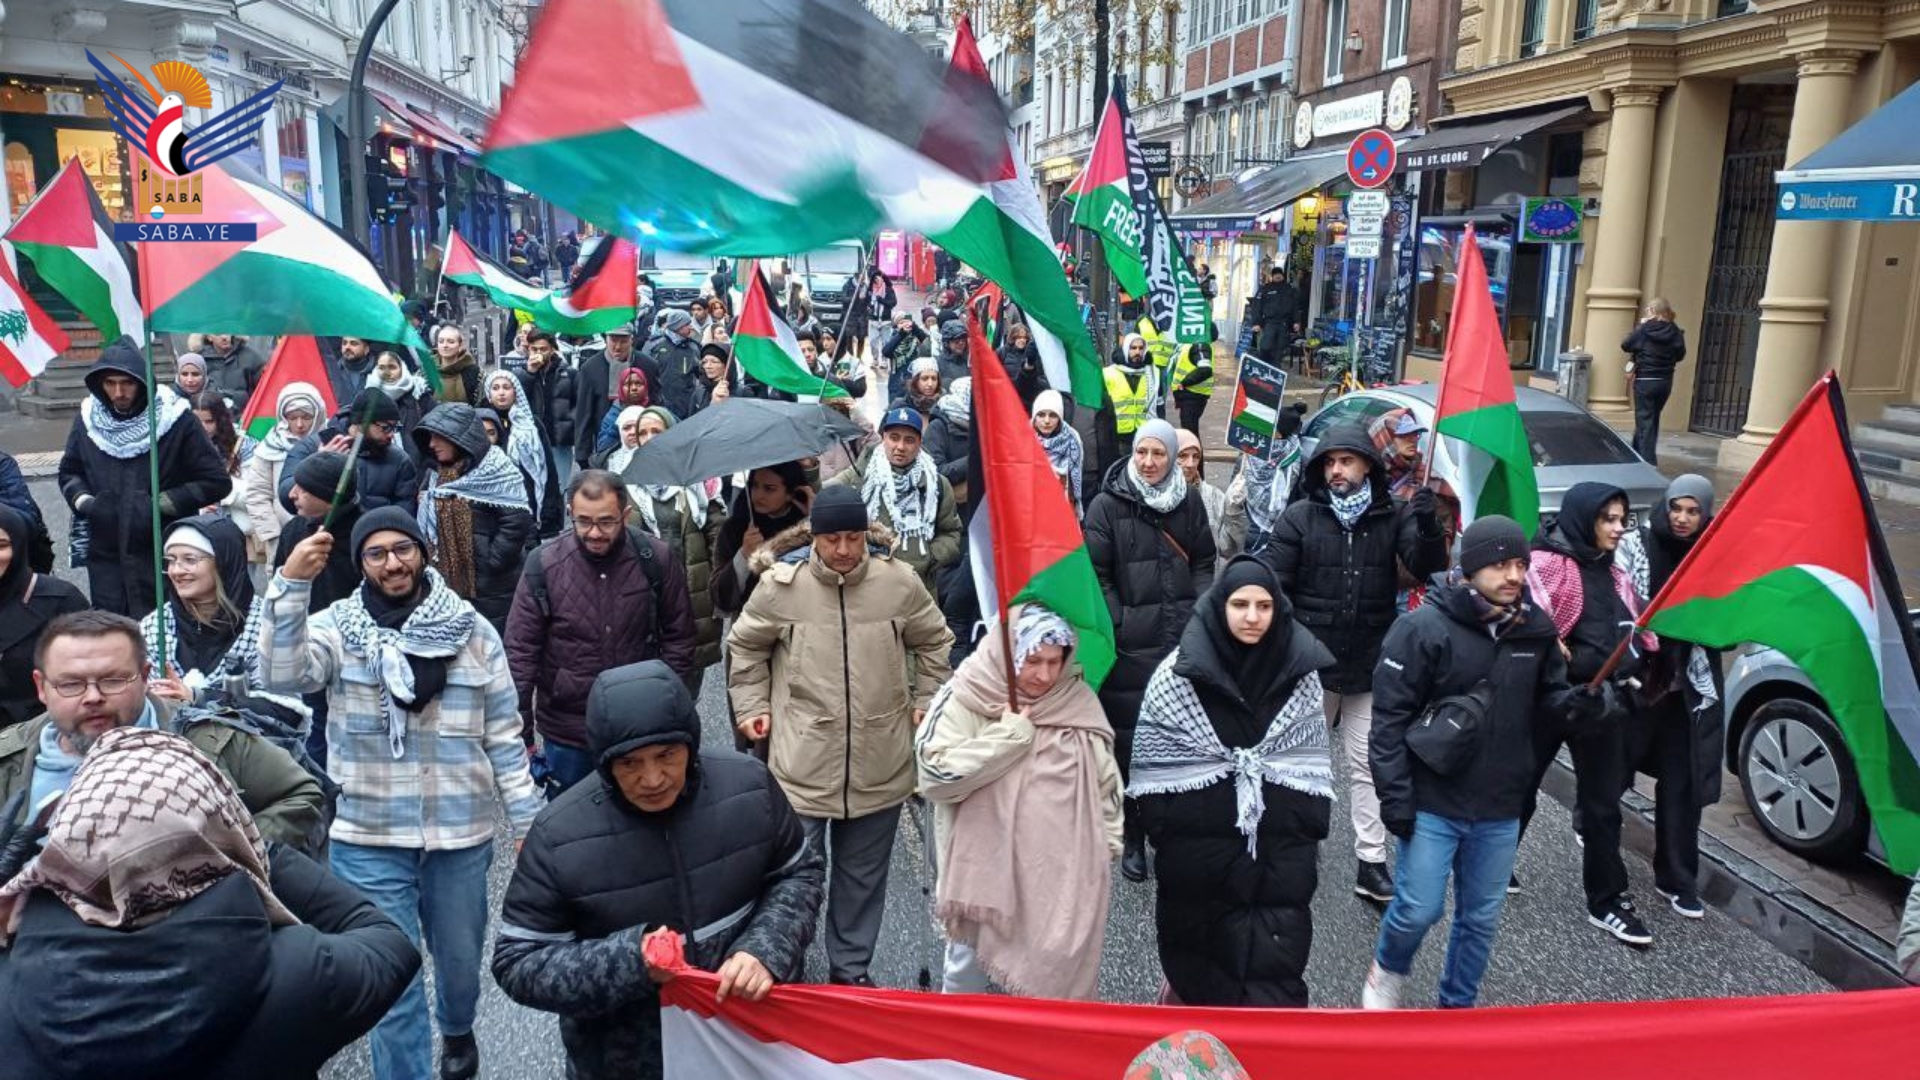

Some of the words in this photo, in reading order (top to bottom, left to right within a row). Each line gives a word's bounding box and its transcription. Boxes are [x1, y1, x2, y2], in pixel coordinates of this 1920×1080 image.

[1407, 156, 1422, 167] BAR
[1799, 192, 1858, 211] Warsteiner
[1889, 183, 1920, 217] R
[1103, 199, 1140, 248] FREE
